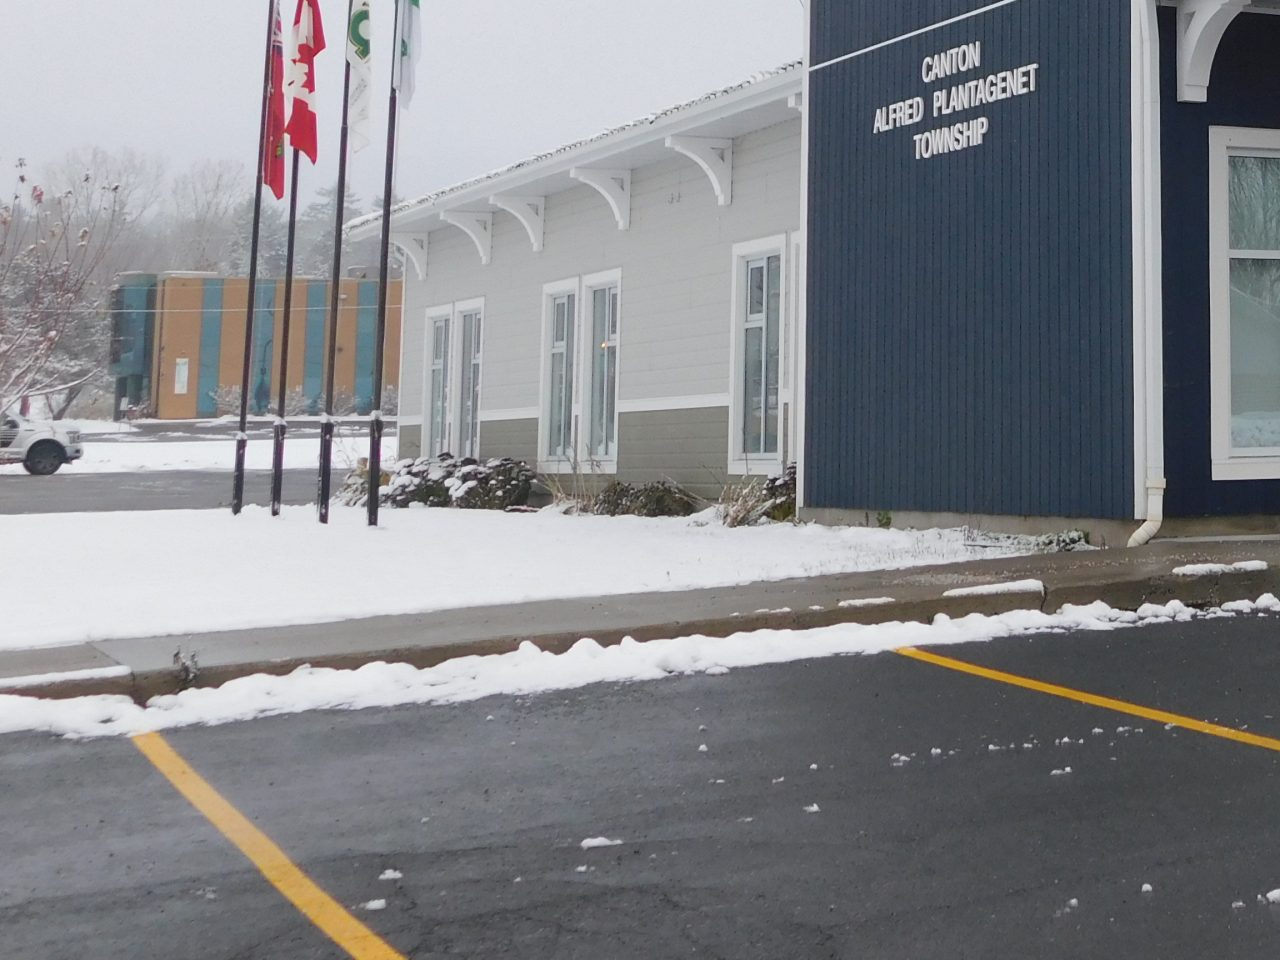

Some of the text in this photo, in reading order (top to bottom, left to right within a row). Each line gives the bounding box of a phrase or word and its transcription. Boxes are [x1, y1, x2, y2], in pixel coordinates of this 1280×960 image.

[922, 41, 981, 83] CANTON
[873, 63, 1039, 134] ALFRED PLANTAGENET
[913, 117, 989, 159] TOWNSHIP
